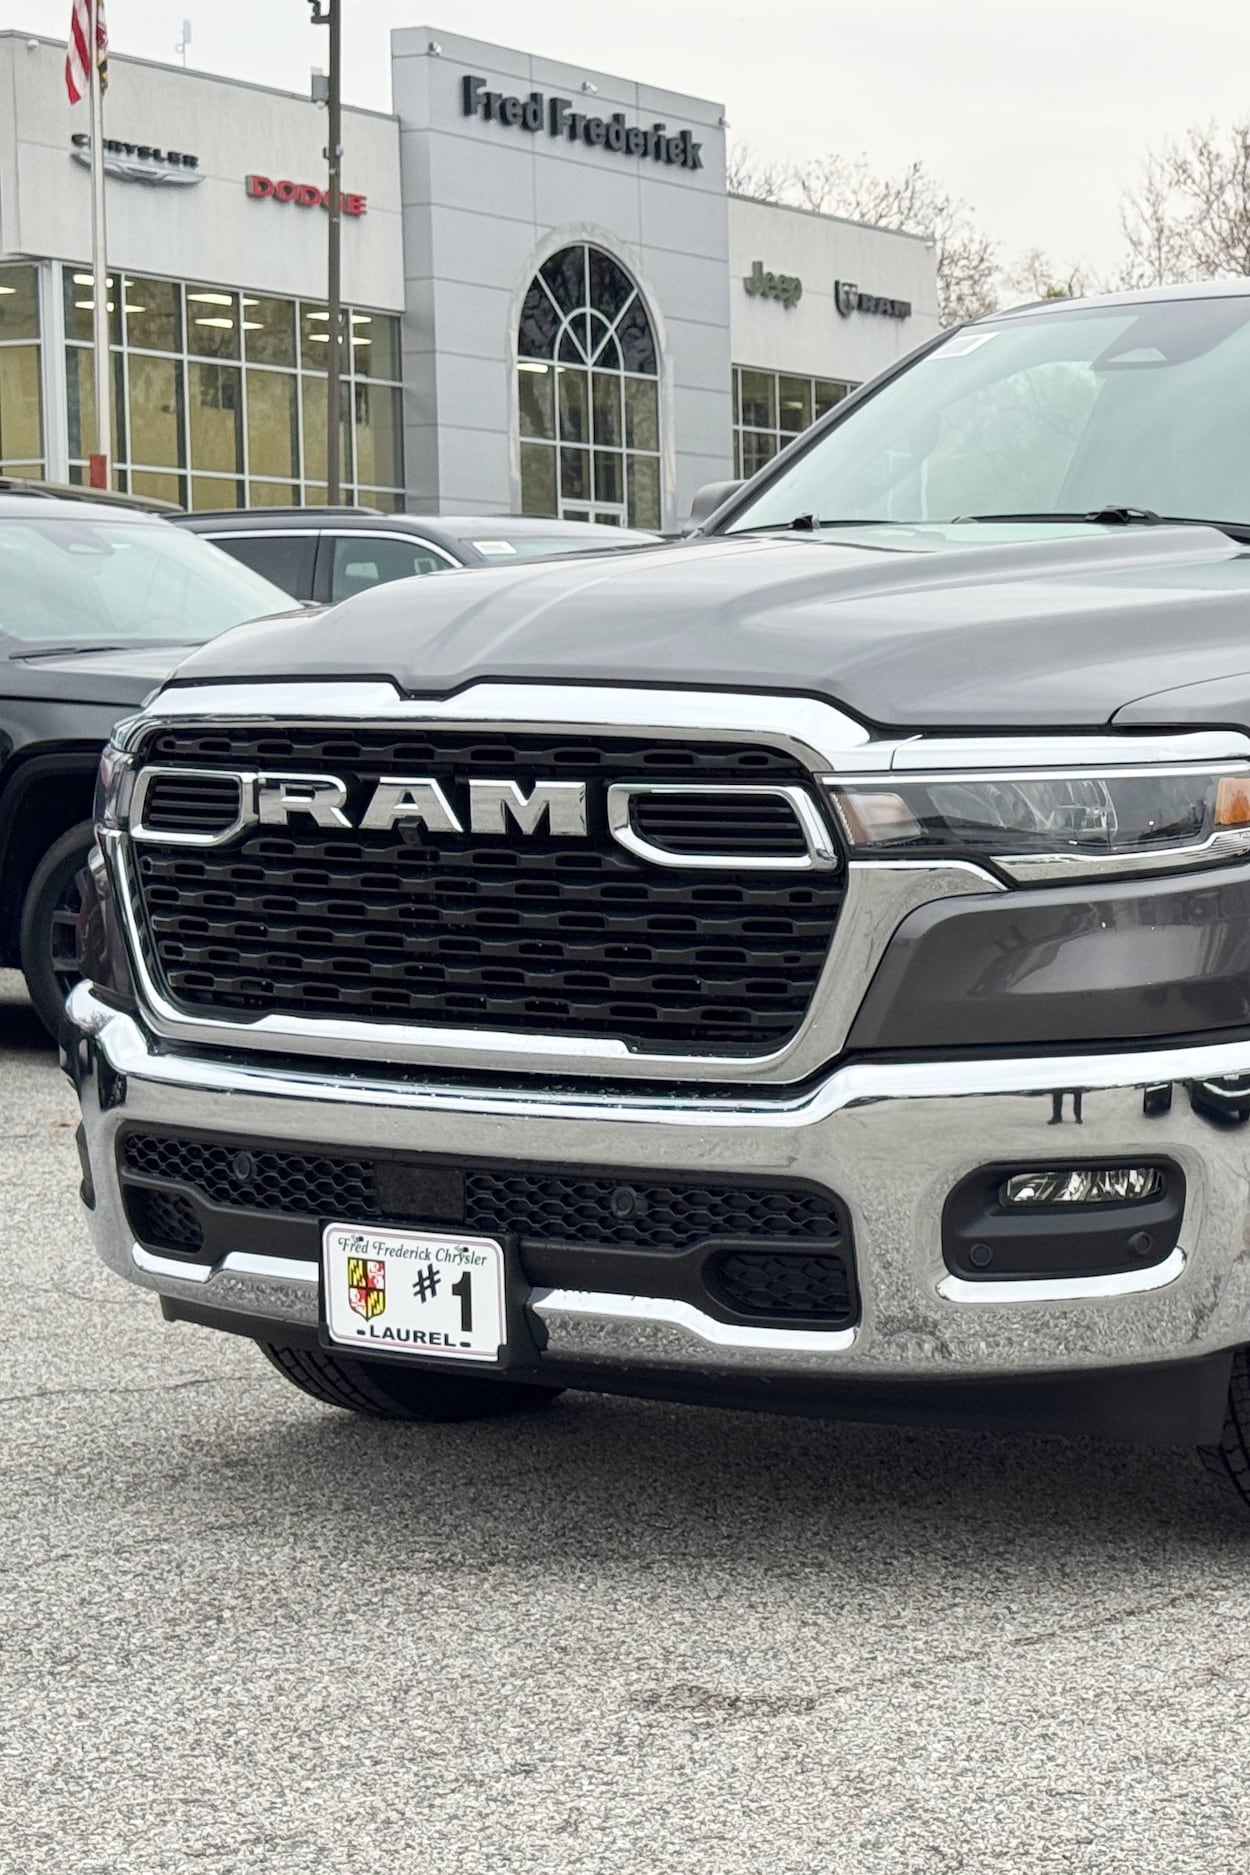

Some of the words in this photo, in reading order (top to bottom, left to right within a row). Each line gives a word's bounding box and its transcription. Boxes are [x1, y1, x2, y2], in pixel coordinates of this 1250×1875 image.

[463, 75, 544, 132] Fred
[549, 97, 703, 170] Frederick
[71, 133, 199, 167] CRYSLER
[743, 260, 802, 310] Jeep
[257, 771, 588, 837] RAM
[337, 1236, 370, 1253] Fred
[372, 1240, 433, 1262] Frederick
[435, 1246, 488, 1267] Chrysler
